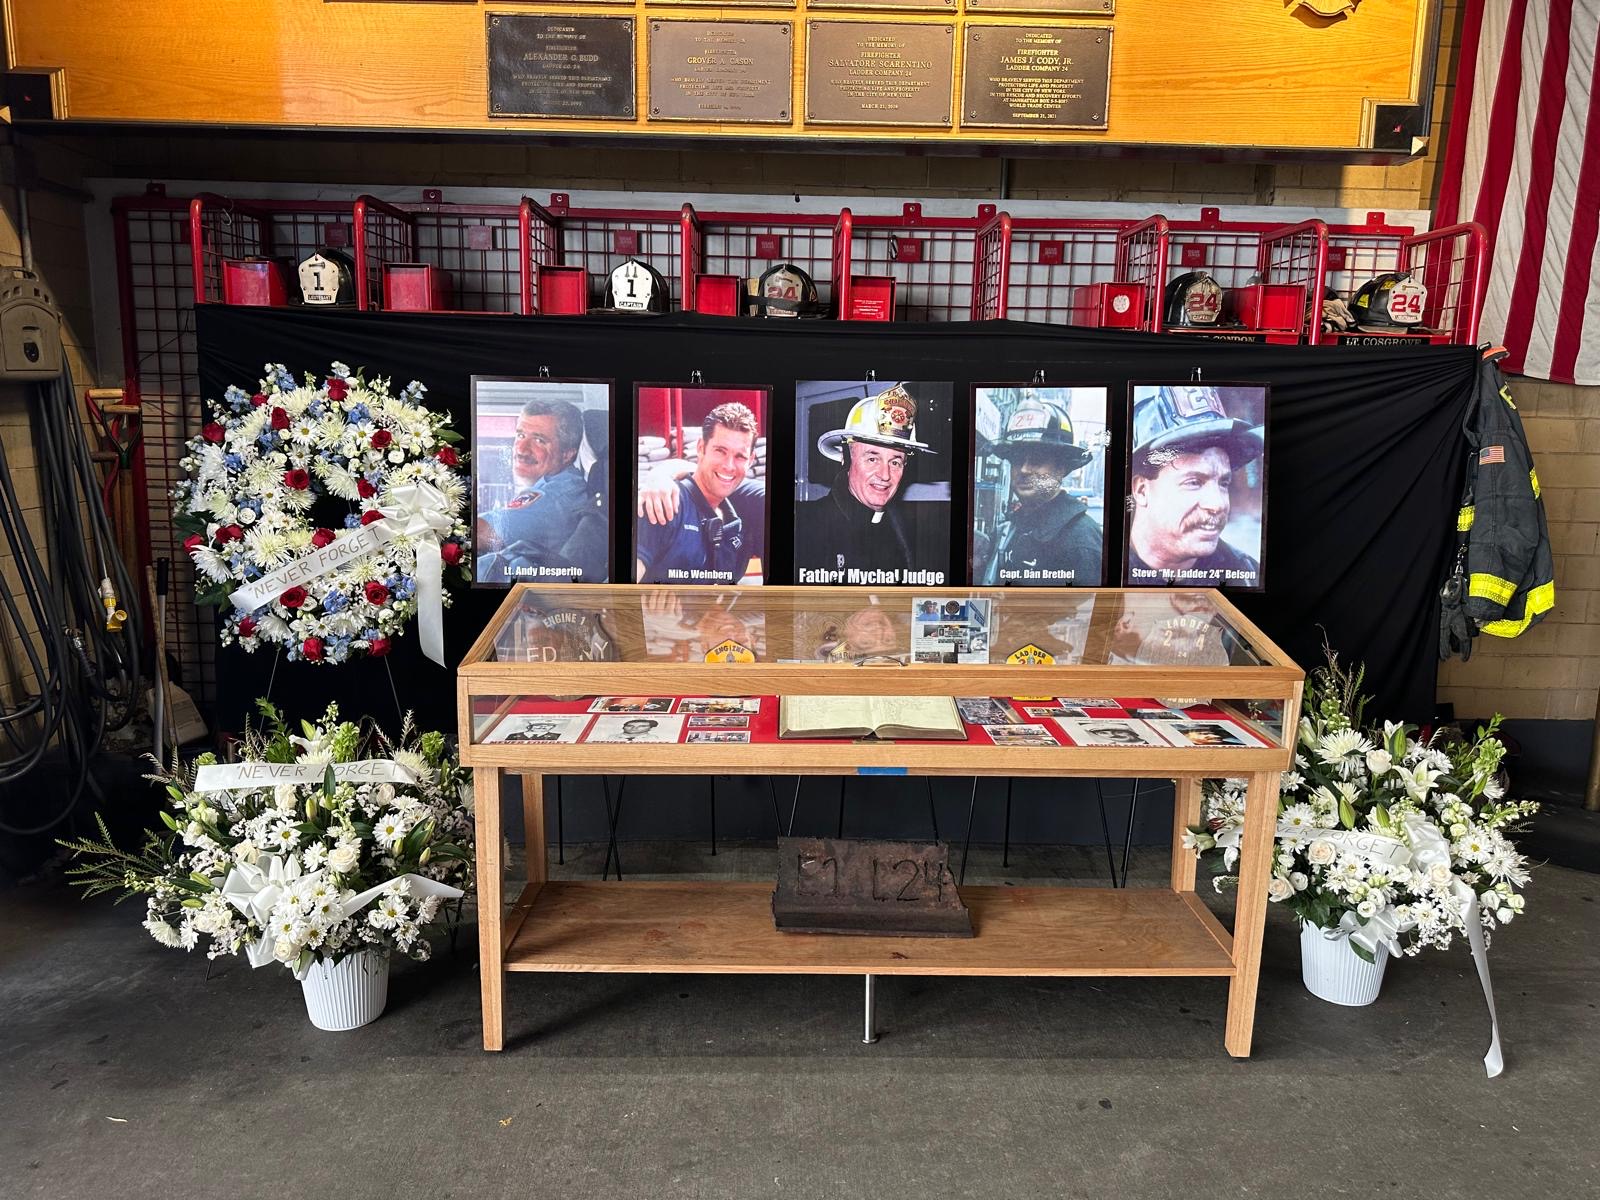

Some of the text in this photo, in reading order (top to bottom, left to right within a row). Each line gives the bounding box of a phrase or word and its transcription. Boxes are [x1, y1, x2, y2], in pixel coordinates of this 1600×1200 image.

[523, 53, 568, 61] ALEXANDER
[579, 54, 599, 62] BUDD
[687, 57, 717, 65] GROVER
[828, 60, 933, 69] SALVATORE SCARENTINO
[1000, 56, 1027, 64] JAMES
[1036, 57, 1061, 65] CODY,
[1062, 57, 1074, 65] JR.
[313, 272, 324, 291] 1
[627, 279, 637, 297] 1
[768, 287, 798, 301] 24
[1190, 292, 1217, 311] 24
[1391, 294, 1420, 313] 24
[1346, 337, 1421, 346] LT. COSGROVE
[251, 526, 380, 598] NEVER FORGET
[504, 567, 582, 578] Lt. Andy Desperito
[668, 569, 733, 580] Mike Weinberg
[799, 568, 944, 584] Father Mychal Judge
[1000, 569, 1075, 580] Capt. Dan Brethel
[1132, 568, 1157, 578] Steve
[1177, 570, 1208, 579] Ladder
[1225, 569, 1256, 580] Belson
[543, 613, 577, 628] ENGINE
[527, 646, 557, 662] FD
[237, 765, 307, 779] NEVER
[1319, 830, 1403, 858] FORGET
